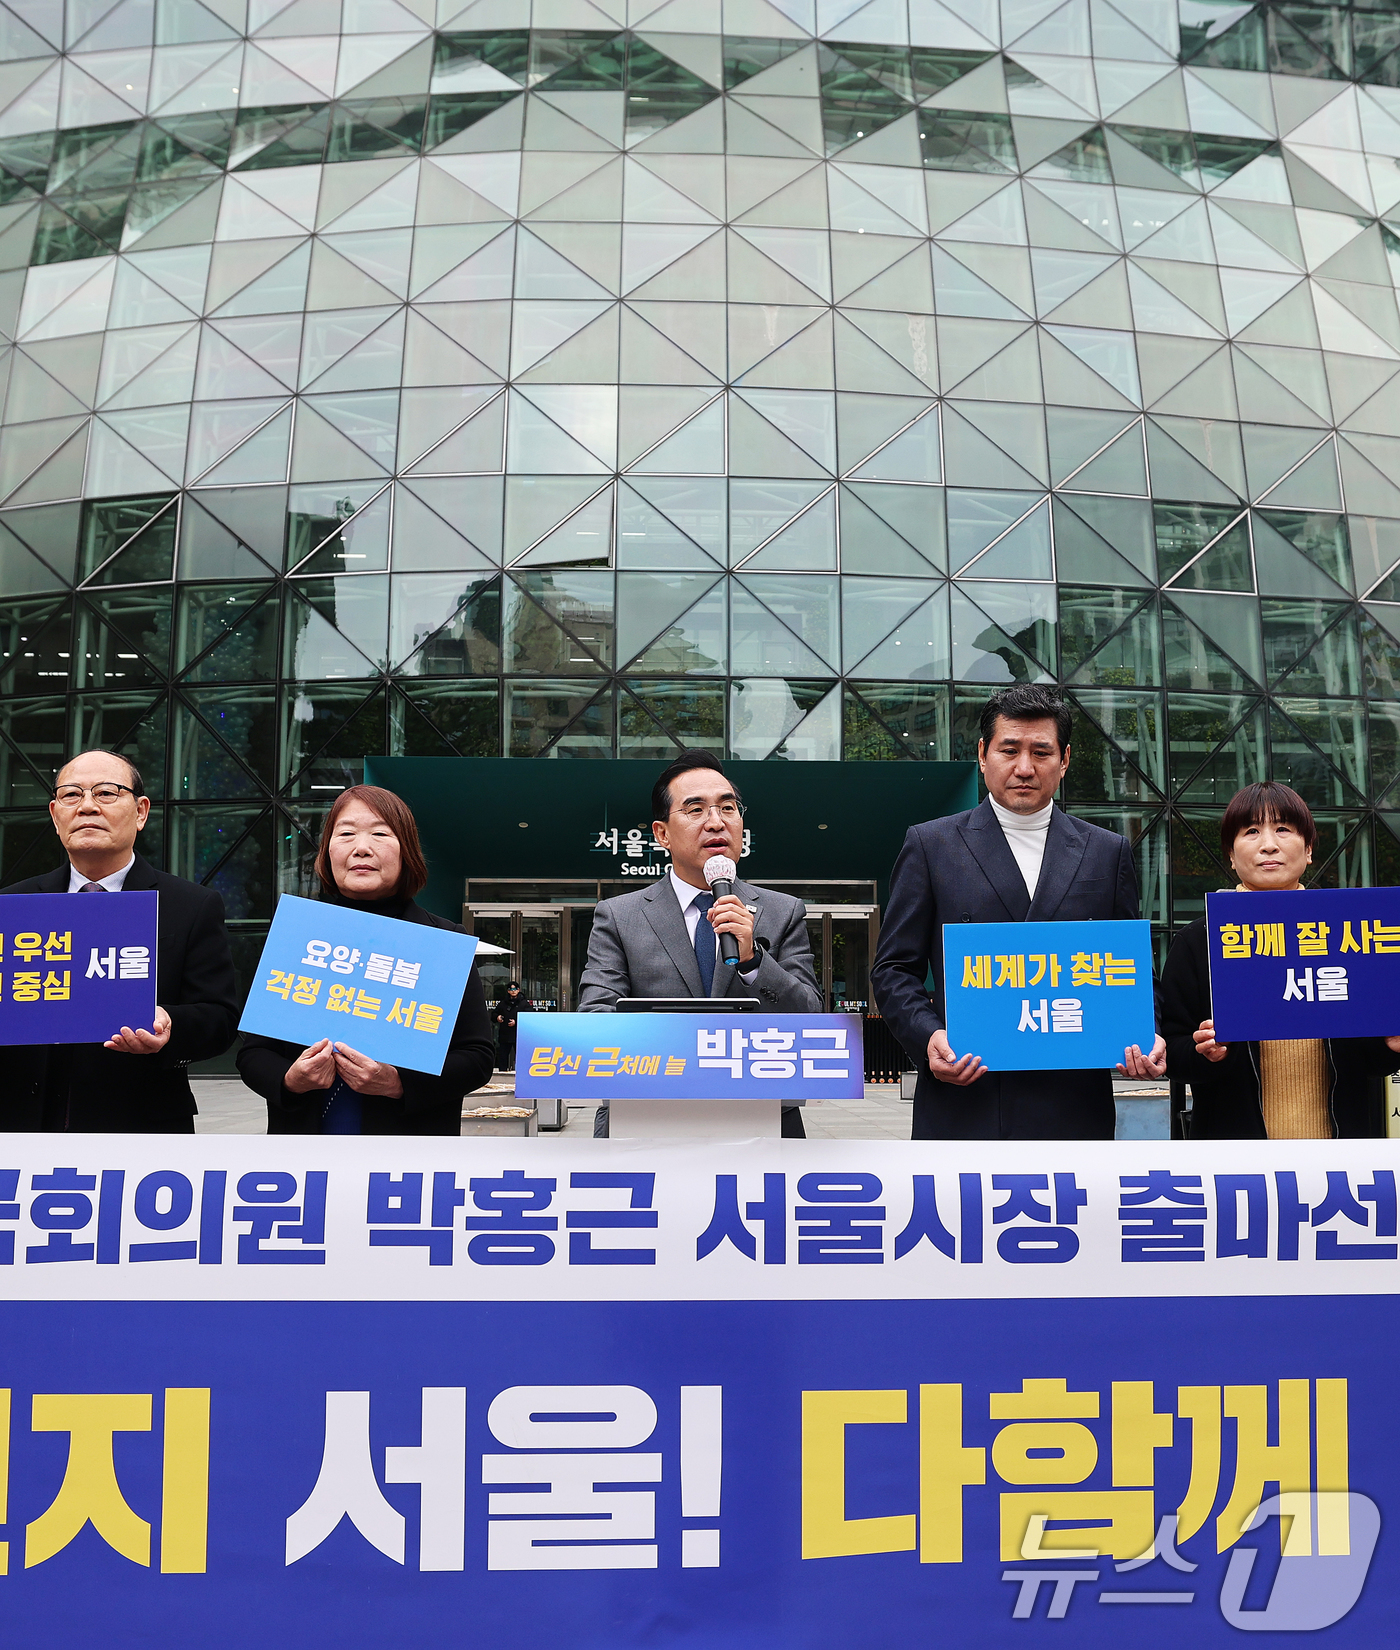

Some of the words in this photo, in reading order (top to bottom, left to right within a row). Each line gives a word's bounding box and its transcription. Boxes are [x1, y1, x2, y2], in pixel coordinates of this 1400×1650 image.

[621, 862, 660, 876] Seoul
[13, 931, 72, 962] 우선
[1219, 922, 1286, 959] 함께
[1296, 921, 1330, 956] 잘
[1339, 919, 1400, 954] 사는
[85, 946, 151, 980] 서울
[961, 953, 1062, 989] 세계가
[1070, 952, 1136, 986] 찾는
[12, 970, 71, 1002] 중심
[265, 969, 322, 1006] 걱정
[325, 984, 381, 1020] 없는
[386, 998, 444, 1034] 서울
[1282, 966, 1349, 1002] 서울
[1017, 998, 1084, 1033] 서울
[528, 1046, 582, 1077] 당신
[585, 1046, 659, 1077] 근처에
[664, 1055, 687, 1075] 늘
[697, 1028, 850, 1079] 박홍근
[367, 1169, 659, 1266] 박홍근
[696, 1171, 1087, 1265] 서울시장
[1118, 1169, 1398, 1262] 출마선
[0, 1387, 211, 1576] 지
[285, 1384, 723, 1572] 서울!
[801, 1377, 1350, 1564] 다함께
